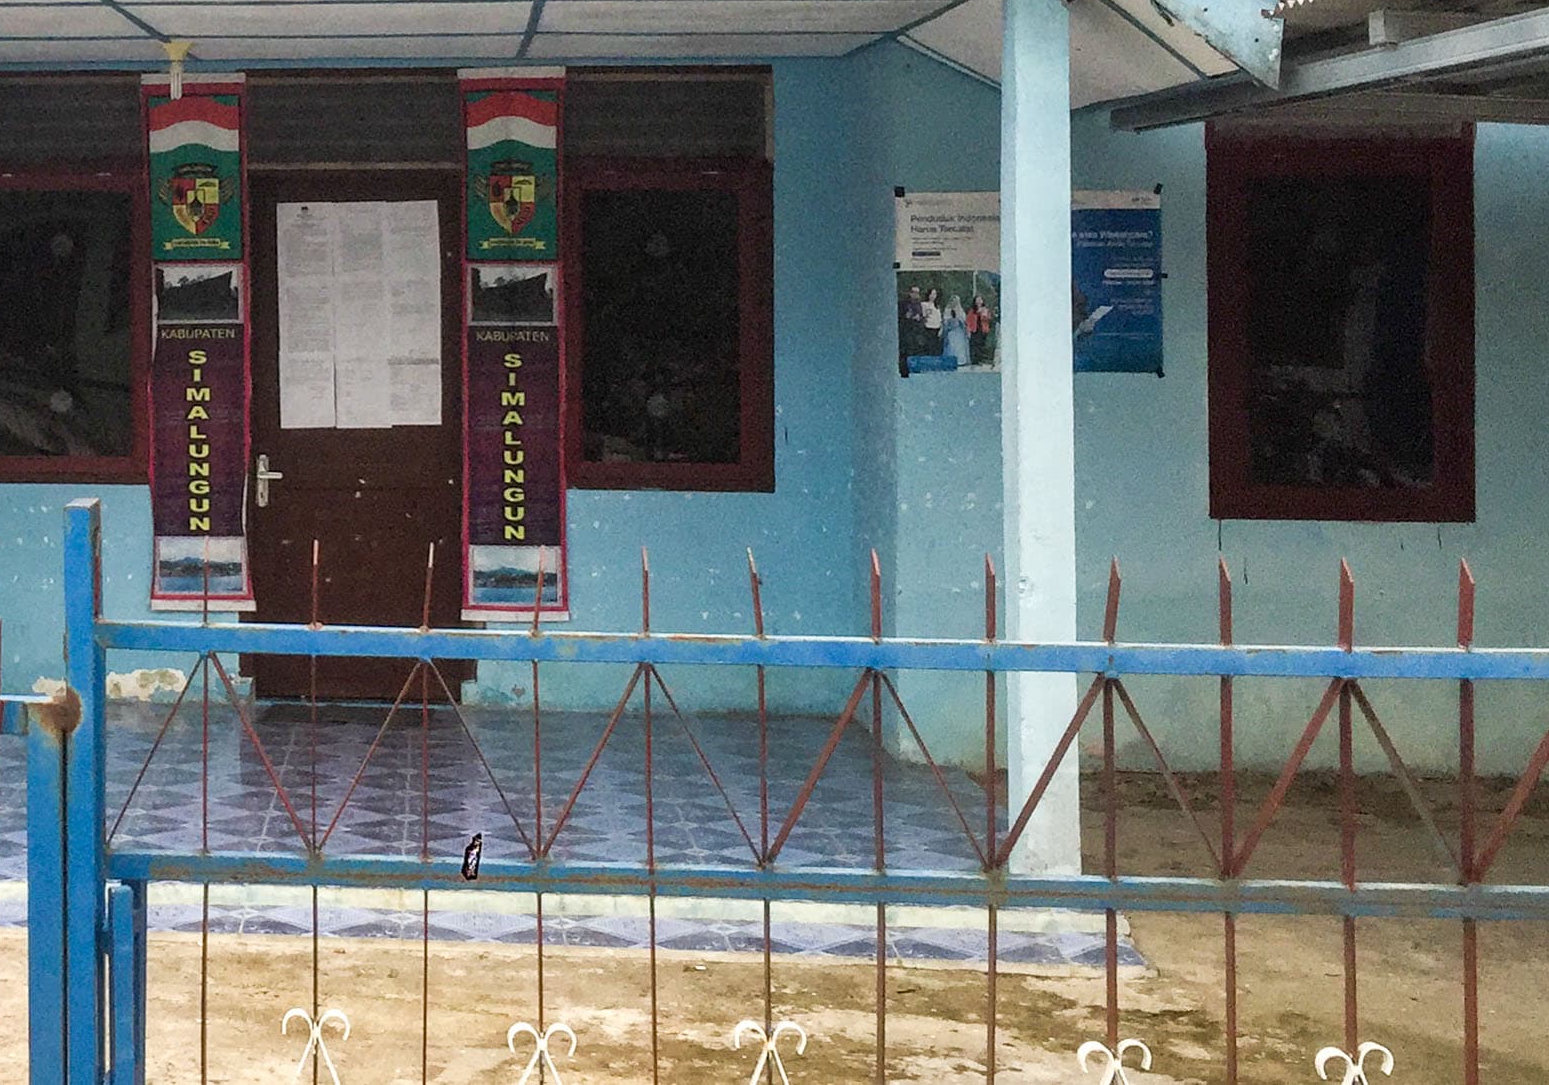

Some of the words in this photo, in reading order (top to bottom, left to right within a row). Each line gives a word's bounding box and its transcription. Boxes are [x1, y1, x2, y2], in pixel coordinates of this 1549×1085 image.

[160, 328, 236, 339] KABUPATEN
[475, 330, 550, 342] KABUPATEN
[185, 350, 211, 532] SIMALUNGUN
[501, 352, 526, 541] SIMALUNGUN
